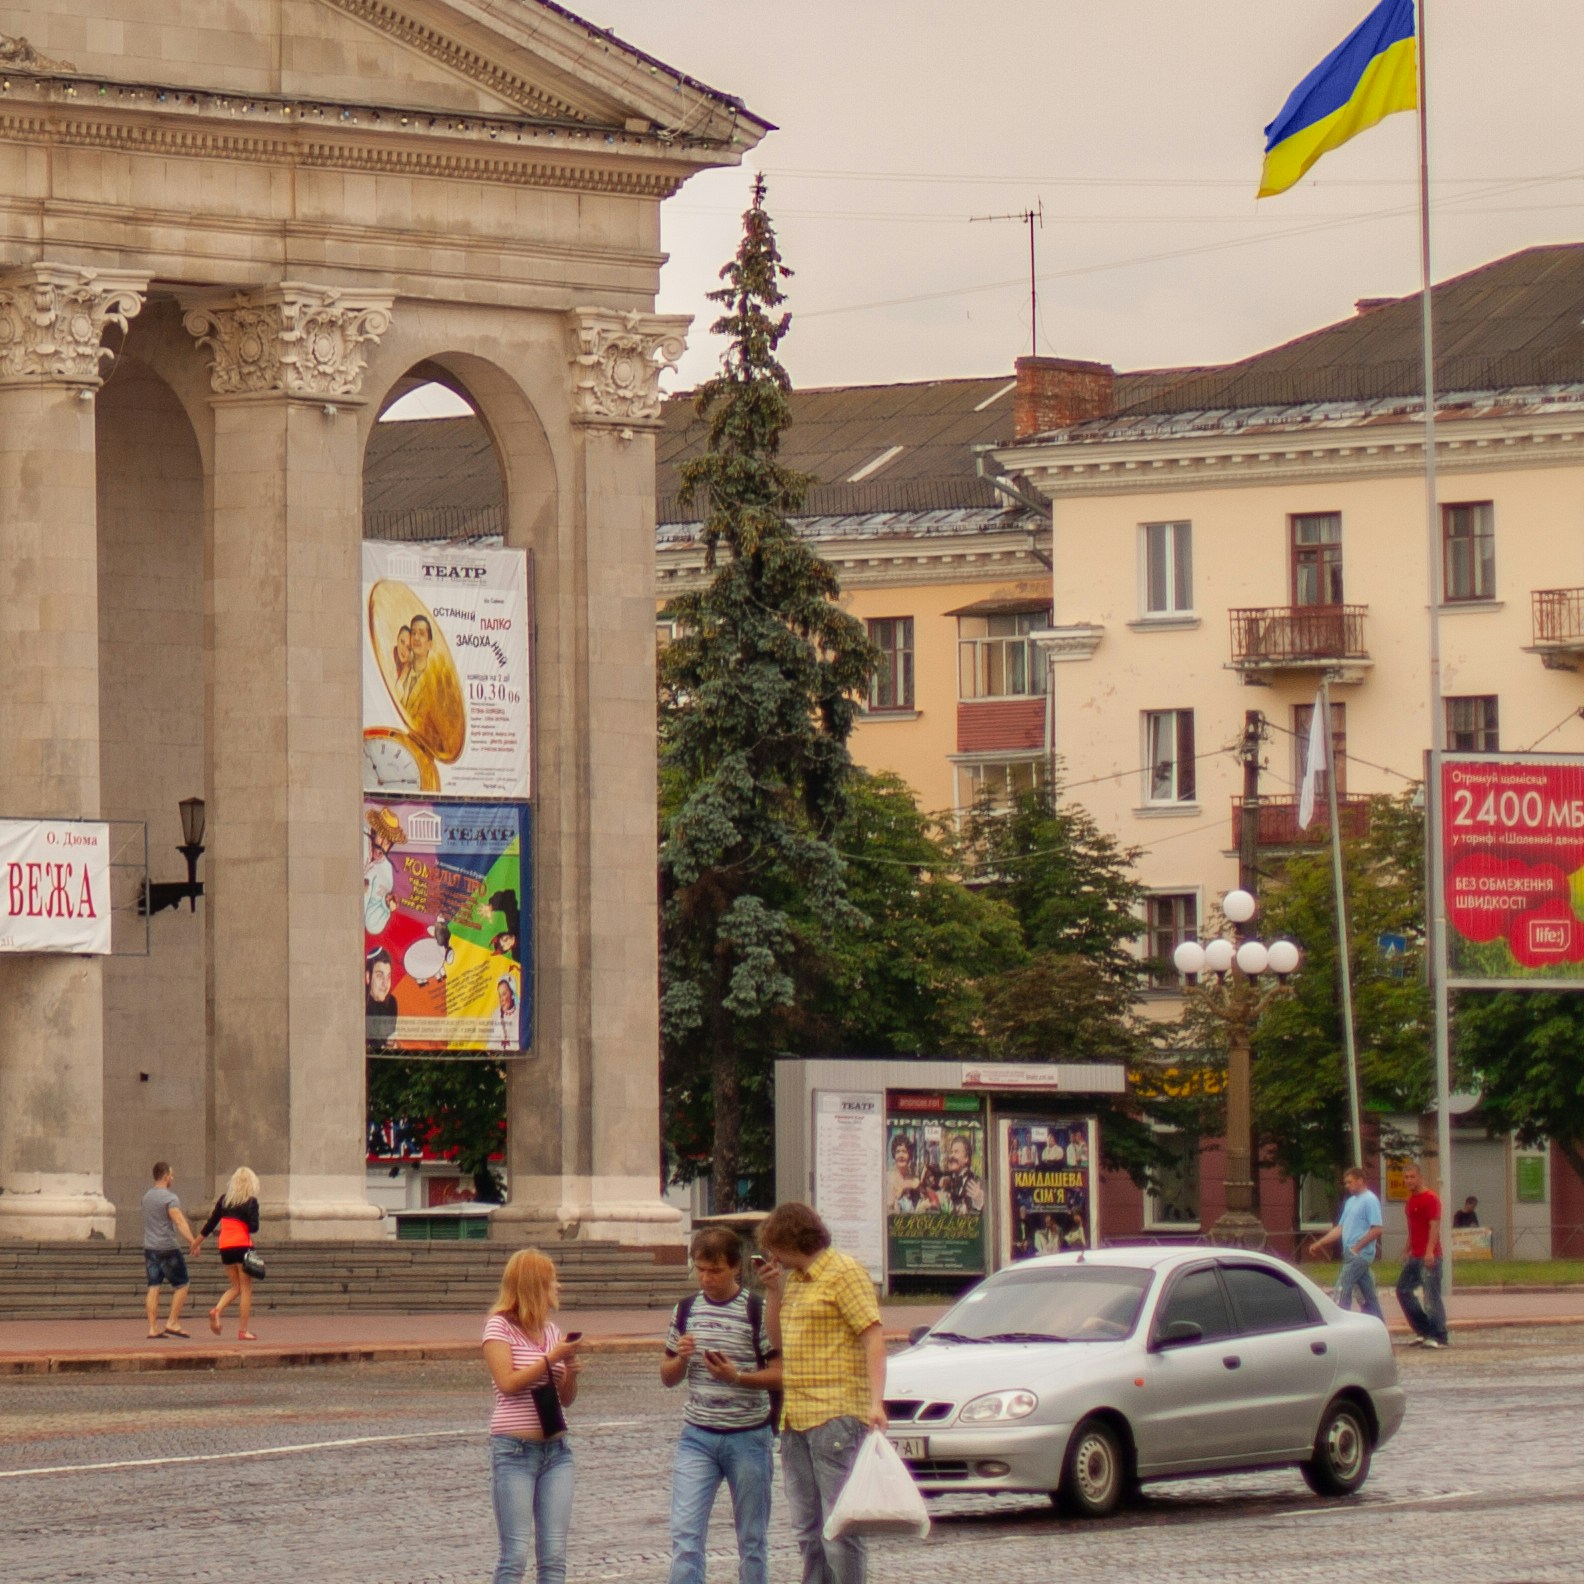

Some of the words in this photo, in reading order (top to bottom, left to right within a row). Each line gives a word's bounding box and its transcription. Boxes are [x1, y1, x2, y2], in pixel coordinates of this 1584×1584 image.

[422, 565, 487, 579] ТЕАТР
[433, 607, 476, 622] ОСТАННІЙ
[480, 618, 512, 630] ПАЛКО
[508, 689, 520, 704] 06
[1452, 771, 1498, 785] Отримуй
[1500, 772, 1547, 785] щомісяця
[1453, 789, 1543, 827] 2400
[46, 831, 59, 845] О.
[63, 832, 98, 847] Дюма
[444, 827, 515, 841] ТЕАТР
[1453, 834, 1459, 846] у
[1461, 832, 1496, 846] тарифі
[7, 861, 97, 919] ВЕЖА
[1455, 877, 1477, 891] БЕЗ
[1479, 878, 1554, 892] ОБМЕЖЕННЯ
[1455, 896, 1526, 910] ШВИДКОСТІ
[842, 1102, 874, 1110] ТЕАТР
[1015, 1170, 1082, 1187] КАЙДАШЕВА
[1033, 1188, 1065, 1204] СІМ'Я
